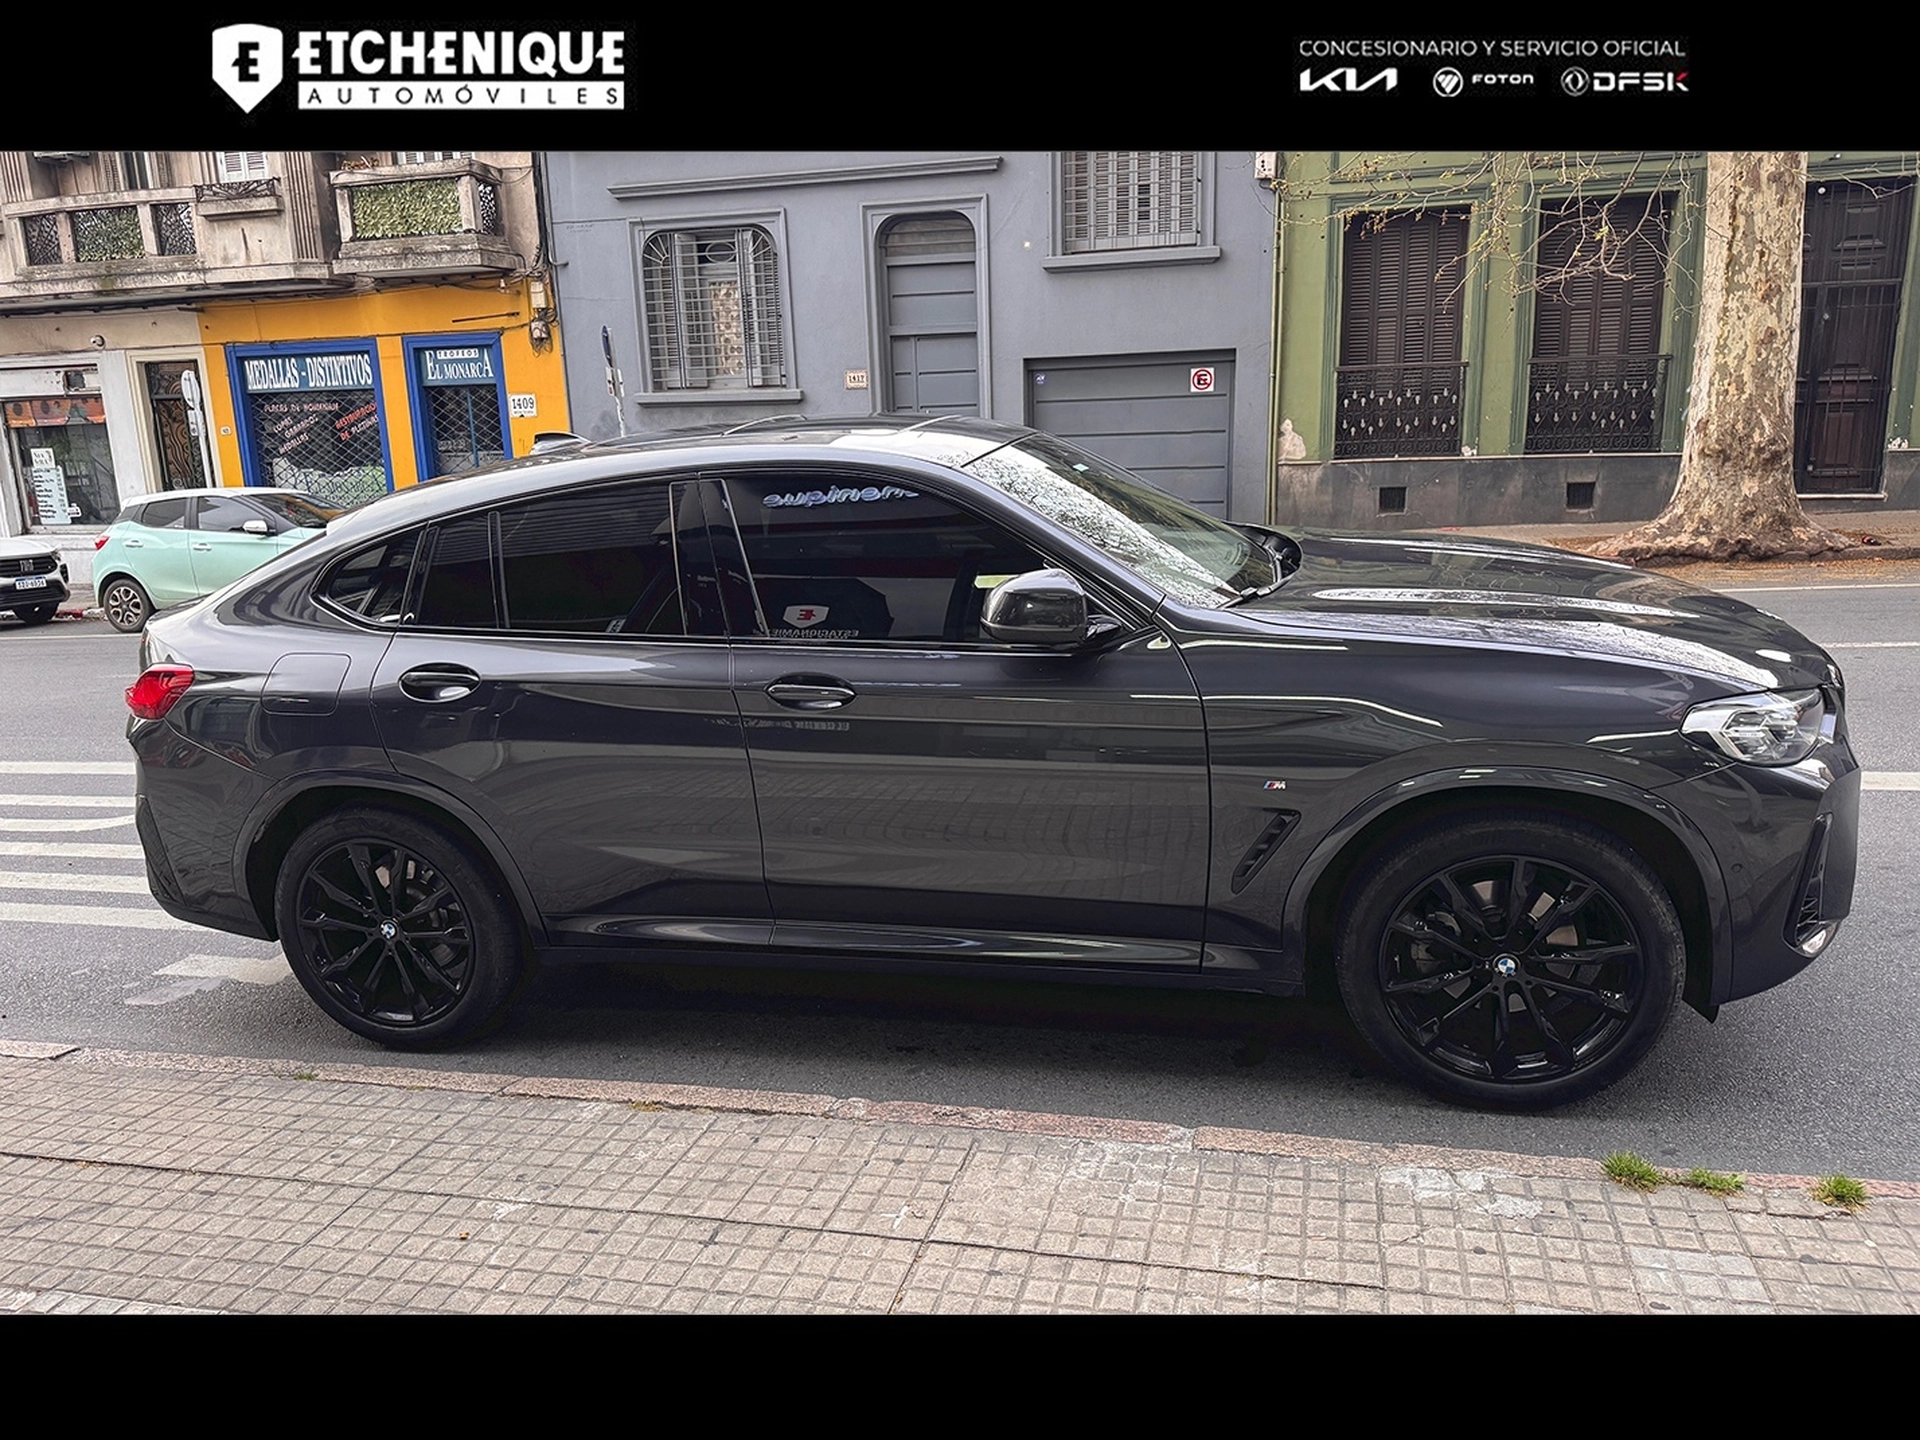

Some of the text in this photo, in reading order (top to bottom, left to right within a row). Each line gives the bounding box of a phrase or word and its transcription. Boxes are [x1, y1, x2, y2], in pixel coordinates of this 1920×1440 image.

[438, 350, 478, 359] TROFEOS
[444, 349, 494, 379] MONARCA
[244, 357, 300, 390] MEDALLAS
[305, 354, 373, 388] DISTINTIVOS
[511, 397, 535, 410] 1409
